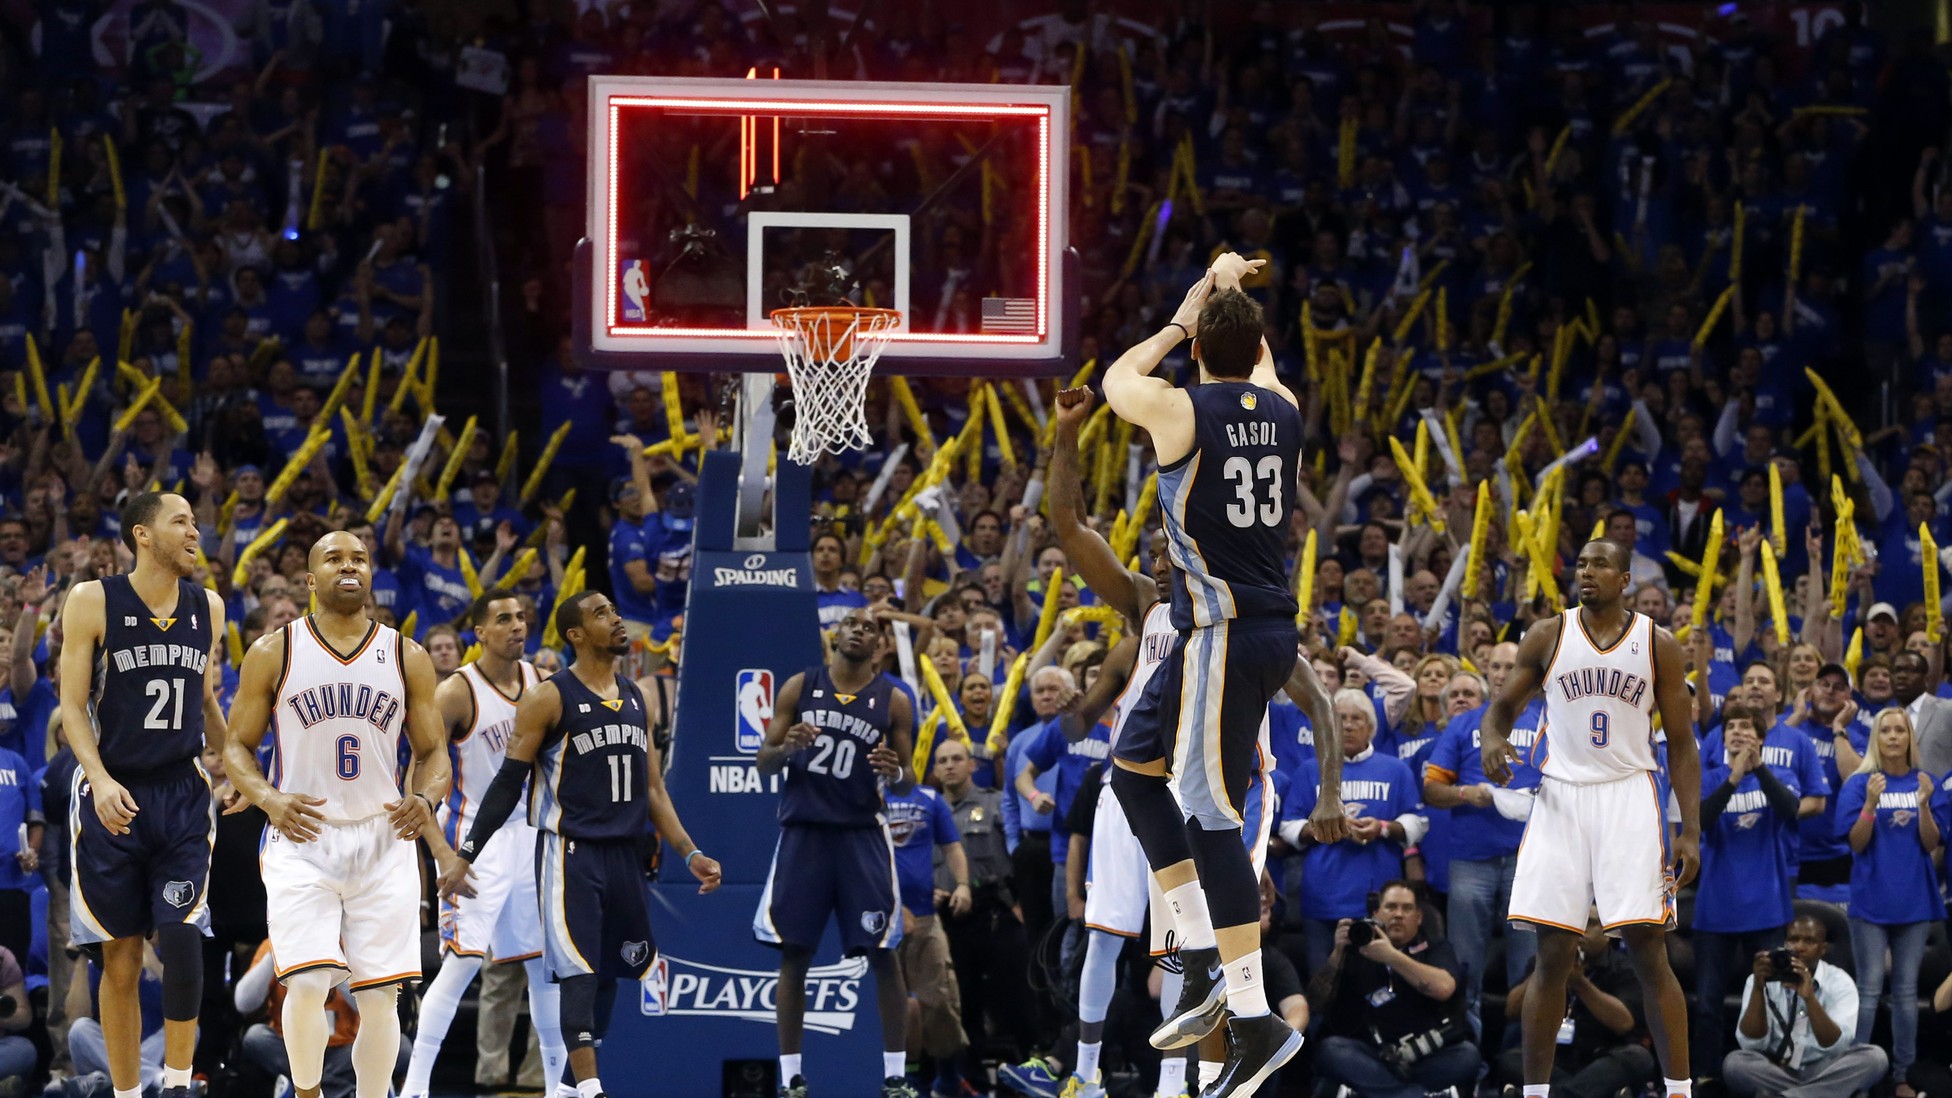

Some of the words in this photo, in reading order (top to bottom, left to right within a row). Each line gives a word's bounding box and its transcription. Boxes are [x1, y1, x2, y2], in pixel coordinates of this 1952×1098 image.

[1225, 421, 1278, 448] GASOL
[1223, 454, 1283, 528] 33
[714, 567, 798, 588] SPALDING
[112, 643, 208, 675] MEMPHIS
[143, 677, 186, 730] 21
[1557, 667, 1647, 708] THUNDER
[287, 682, 399, 735] THUNDER
[801, 709, 880, 745] MEMPHIS
[1590, 710, 1610, 748] 9
[336, 733, 361, 781] 6
[807, 734, 857, 780] 20
[607, 754, 632, 803] 11
[709, 765, 763, 794] NBA
